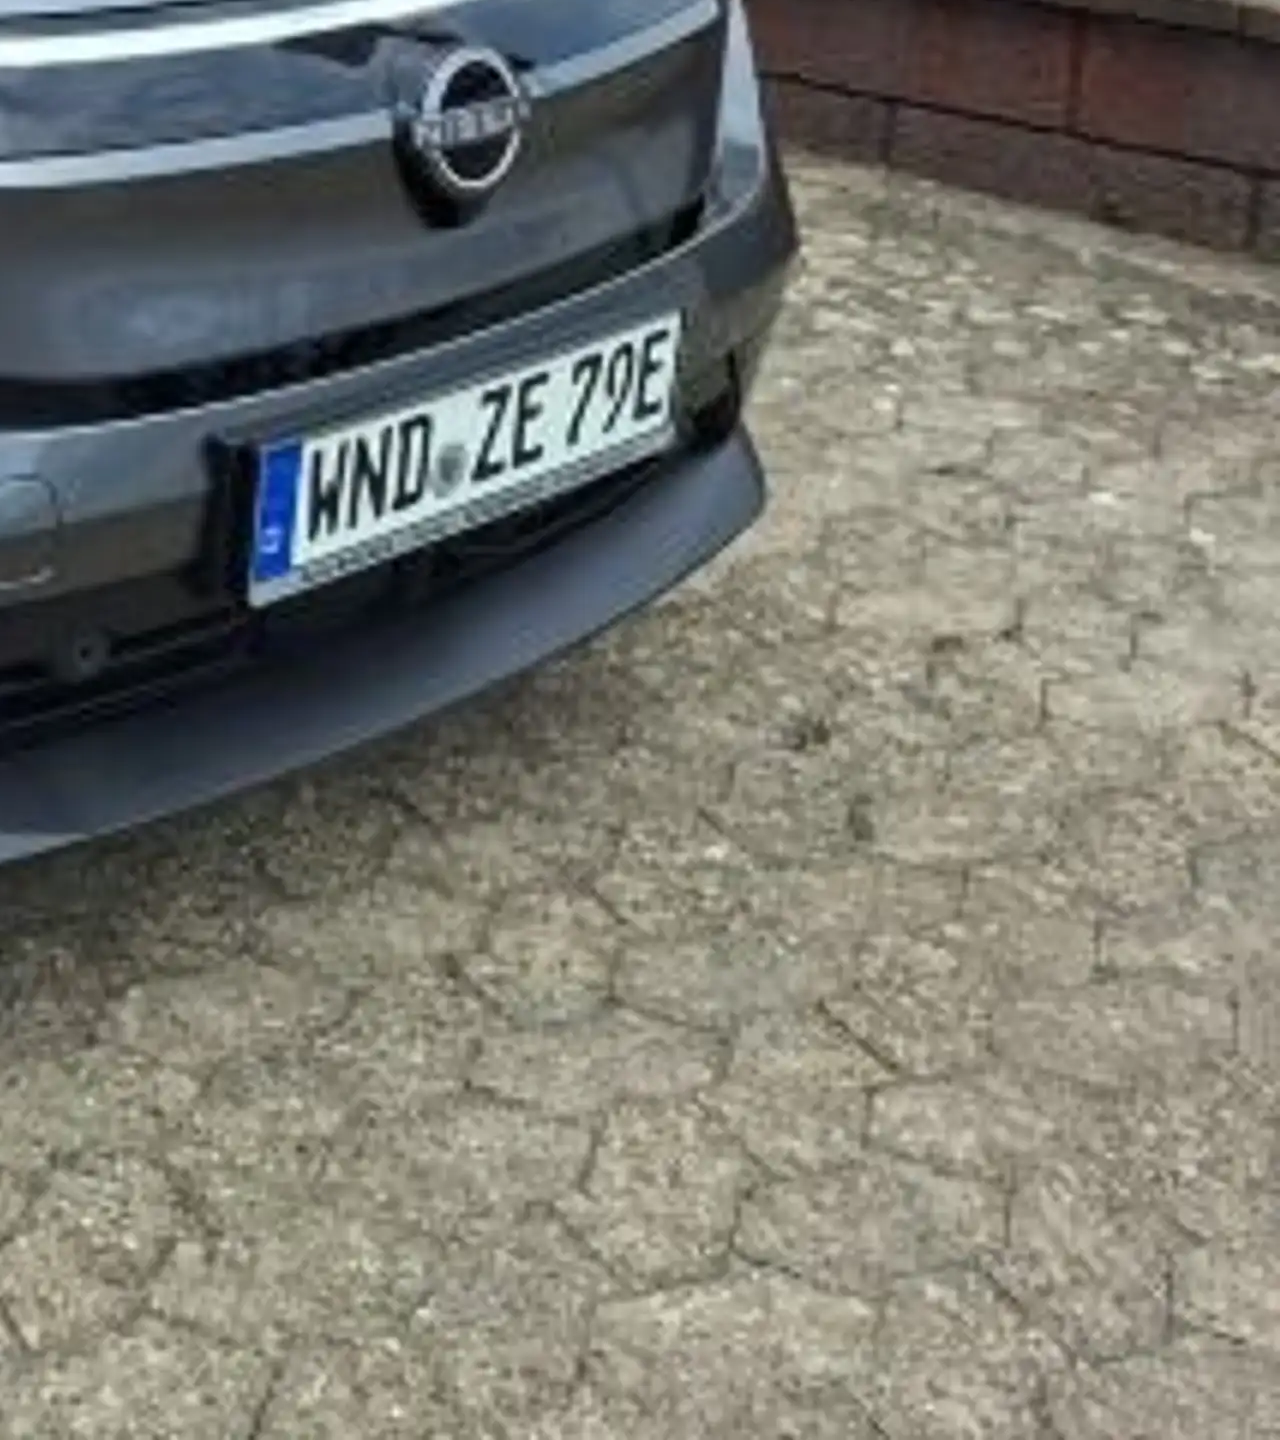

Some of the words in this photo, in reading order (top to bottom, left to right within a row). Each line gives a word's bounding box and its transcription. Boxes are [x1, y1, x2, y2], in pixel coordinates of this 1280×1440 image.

[308, 413, 434, 541] WND
[471, 372, 549, 482] ZE
[566, 329, 669, 446] 79E
